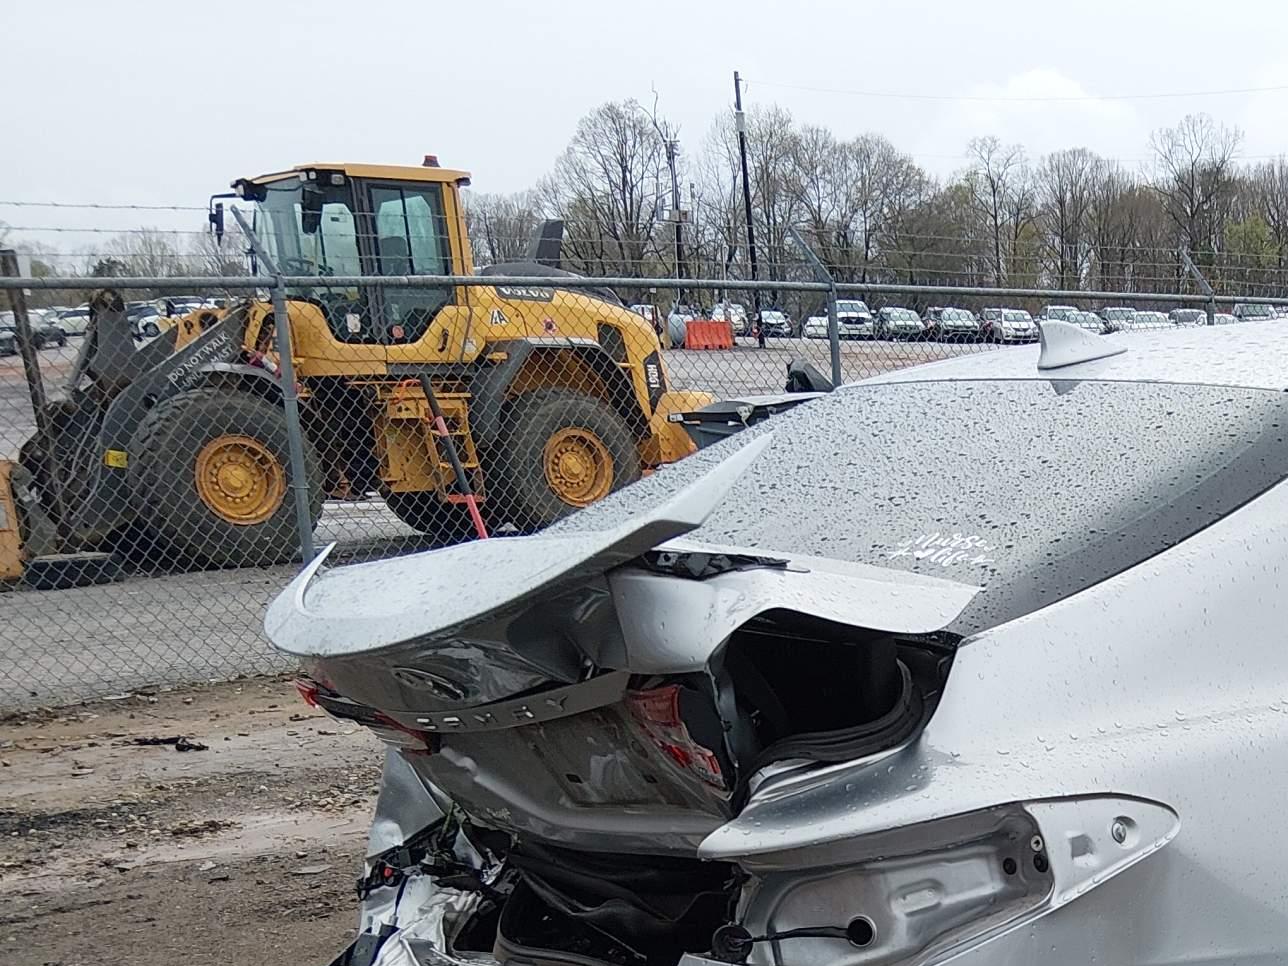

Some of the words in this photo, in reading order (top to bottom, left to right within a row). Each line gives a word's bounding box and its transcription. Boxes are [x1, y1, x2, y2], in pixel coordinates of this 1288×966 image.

[168, 367, 185, 382] DO
[183, 349, 205, 372] NOT
[201, 332, 231, 355] WALK
